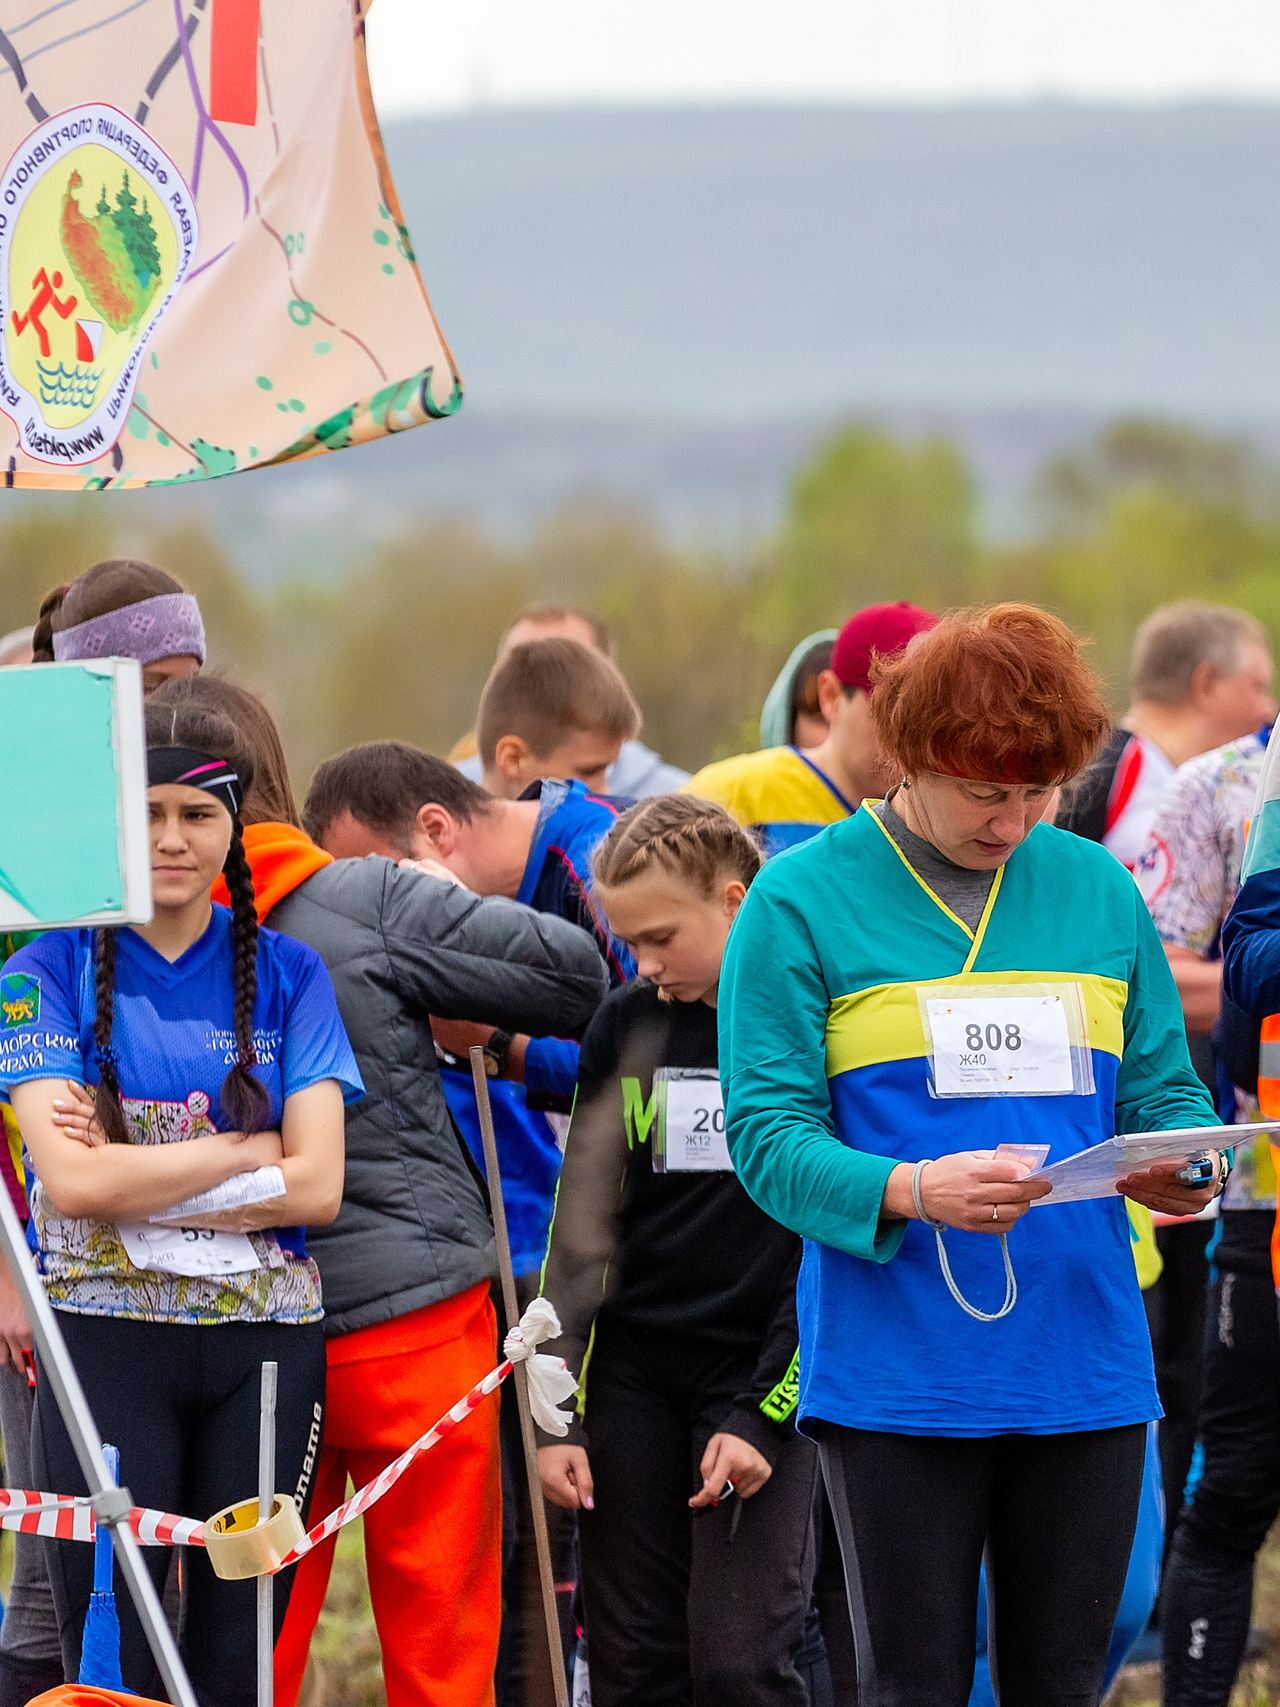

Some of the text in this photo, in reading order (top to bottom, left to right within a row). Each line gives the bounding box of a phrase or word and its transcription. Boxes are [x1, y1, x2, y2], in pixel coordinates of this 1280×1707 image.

[965, 1023, 1022, 1051] 808
[959, 1054, 987, 1066] Ж40
[685, 1136, 711, 1146] Ж12
